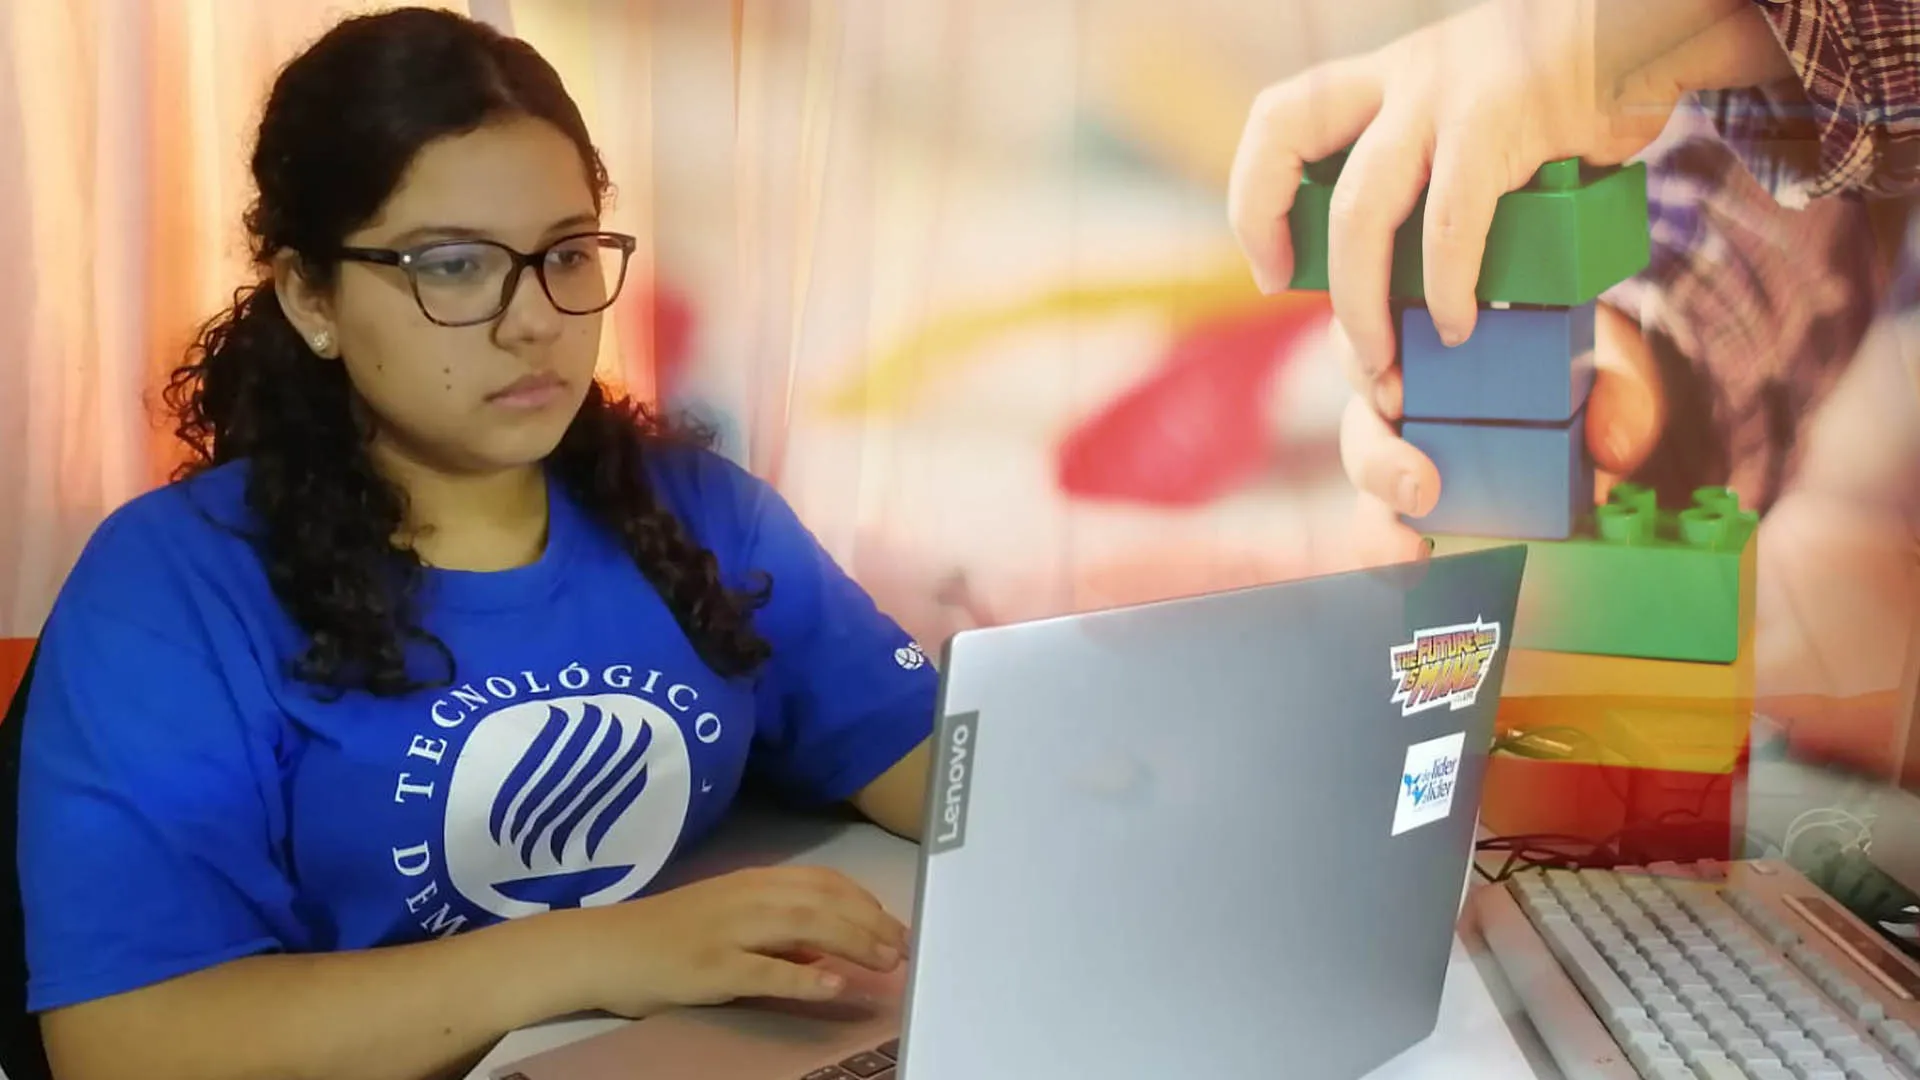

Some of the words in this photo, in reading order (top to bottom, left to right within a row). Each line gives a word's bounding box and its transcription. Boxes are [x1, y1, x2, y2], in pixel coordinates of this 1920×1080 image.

[1404, 649, 1490, 707] MINE
[1416, 630, 1477, 663] FUTURE
[395, 661, 722, 804] TECNOLÓGICO
[937, 724, 969, 844] Lenovo
